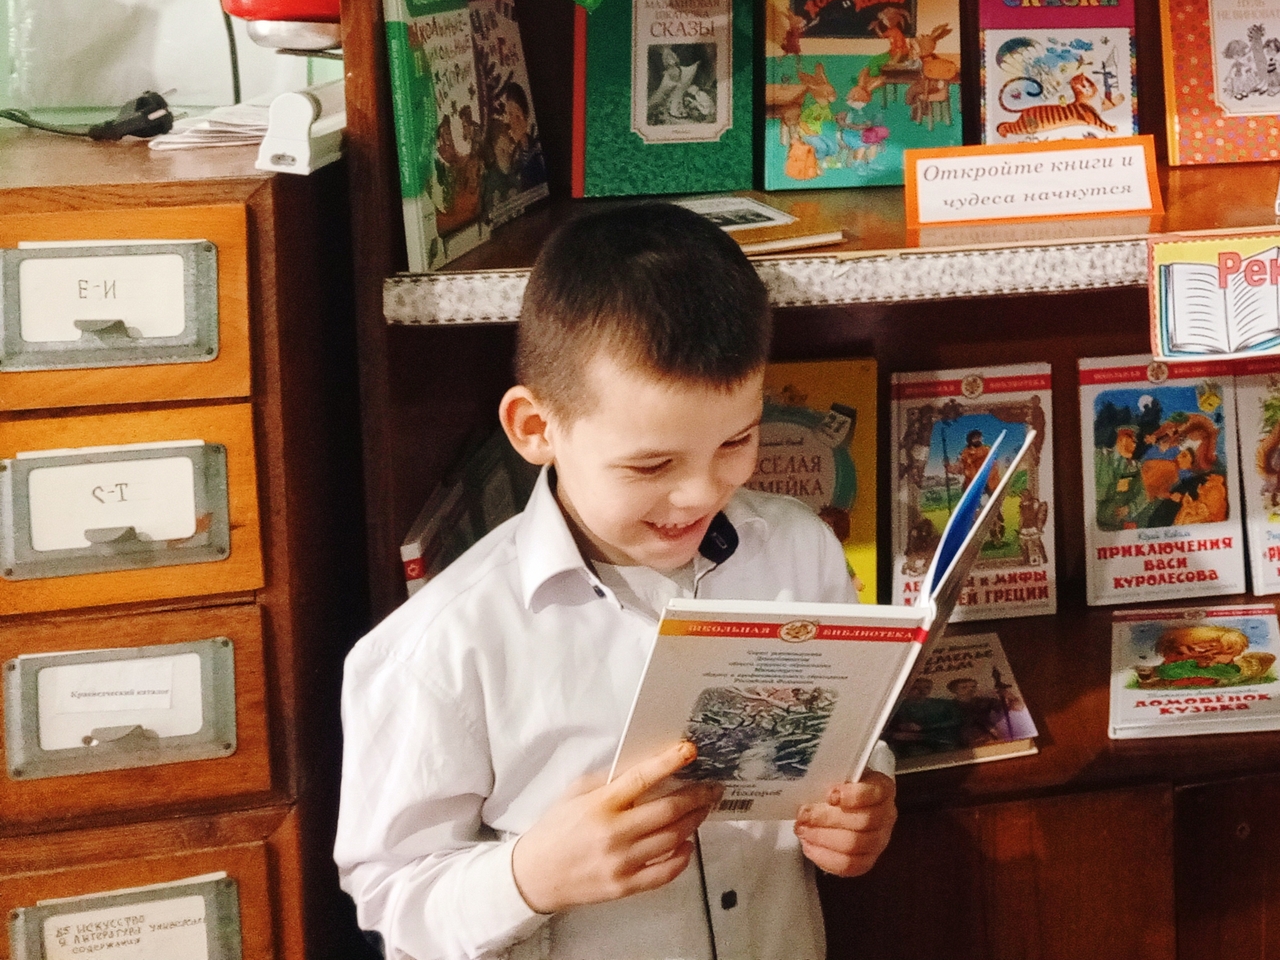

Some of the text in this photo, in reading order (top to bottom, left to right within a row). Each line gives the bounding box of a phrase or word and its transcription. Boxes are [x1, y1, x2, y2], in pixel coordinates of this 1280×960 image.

[650, 21, 716, 38] СКАЗЫ
[922, 154, 1135, 183] Откройте книги и
[941, 183, 1133, 210] чудеса начнутся
[1097, 537, 1233, 560] ПРИКЛЮЧЕНИЯ
[1113, 569, 1219, 589] КУРОЛЕСОВА
[984, 586, 1049, 604] ГРЕЦИИ
[687, 624, 914, 640] ШКОЛЬНАЯ БИБЛИОТЕКА
[1159, 703, 1251, 716] КУЗЬКА
